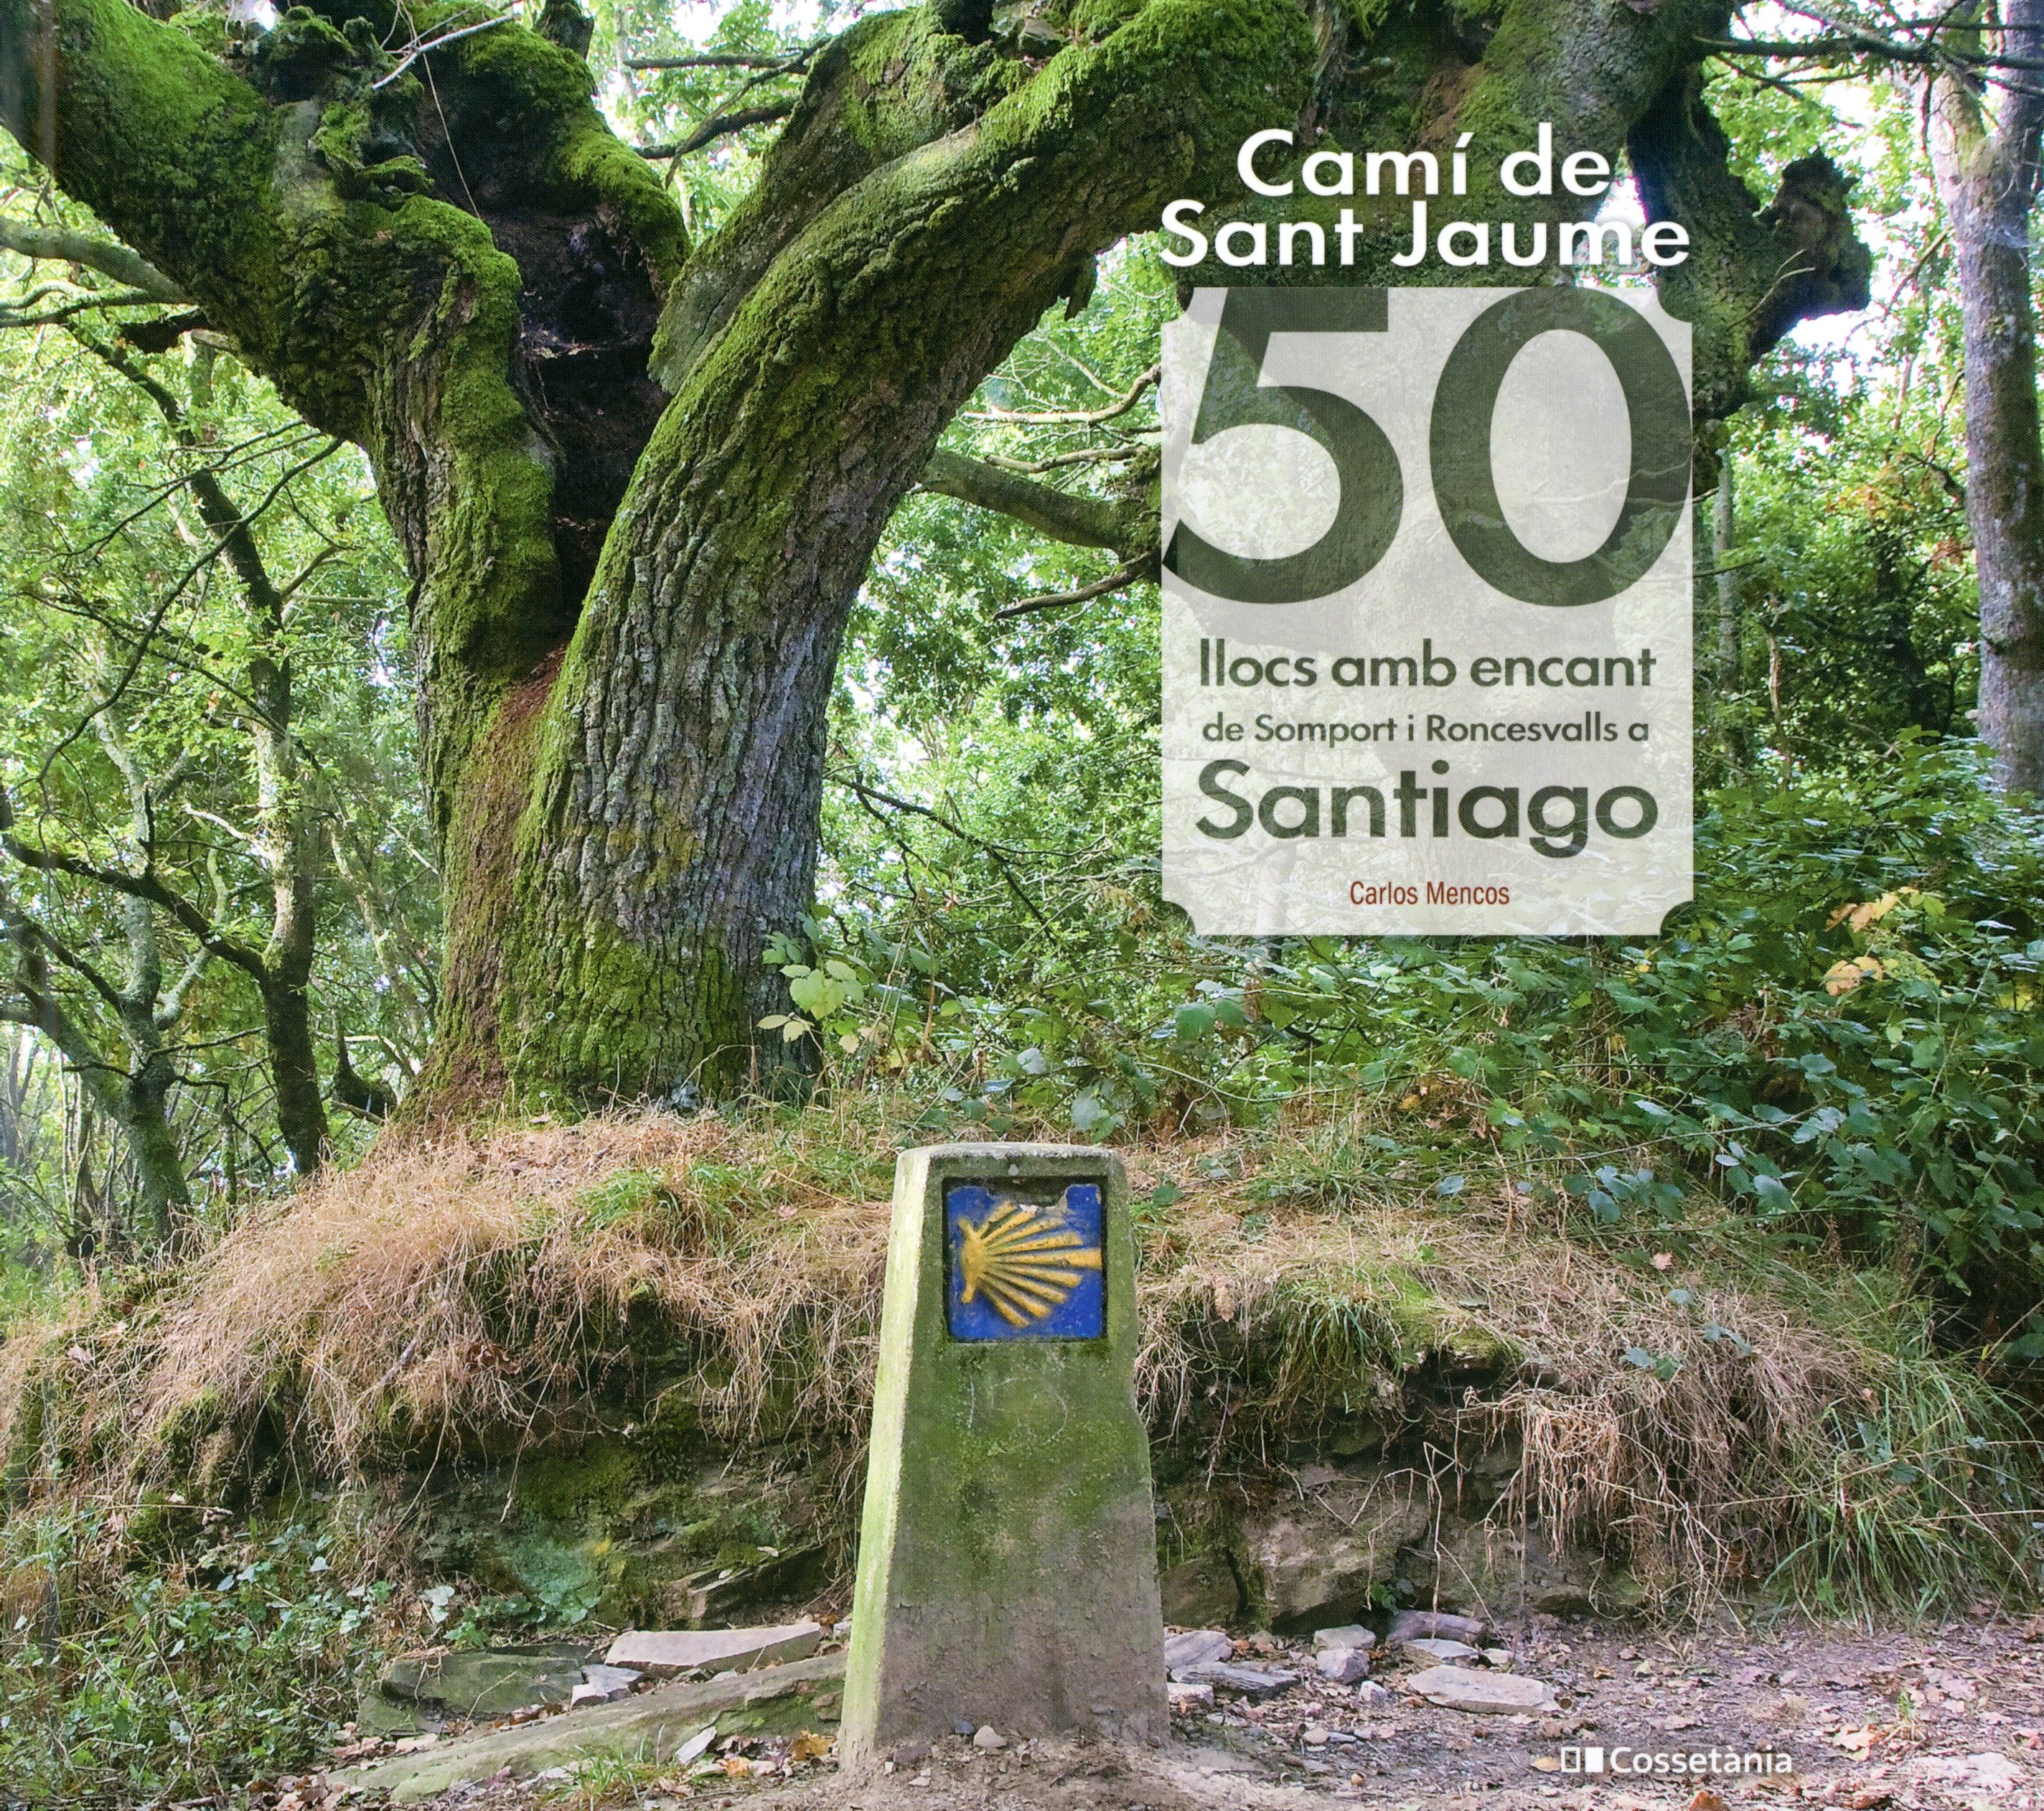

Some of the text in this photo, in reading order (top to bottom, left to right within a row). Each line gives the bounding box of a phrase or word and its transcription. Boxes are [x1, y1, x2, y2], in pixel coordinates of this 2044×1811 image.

[1237, 122, 1610, 197] Camí de
[1160, 200, 1689, 267] Sant Jaume
[1161, 287, 1692, 607] 50
[1201, 638, 1656, 688] llocs amb encant
[1202, 711, 1649, 749] de Somport i Roncesvalls a
[1195, 759, 1659, 858] Santiago
[1350, 880, 1510, 906] Carlos Mencos
[1611, 1745, 1792, 1774] Cossetània
